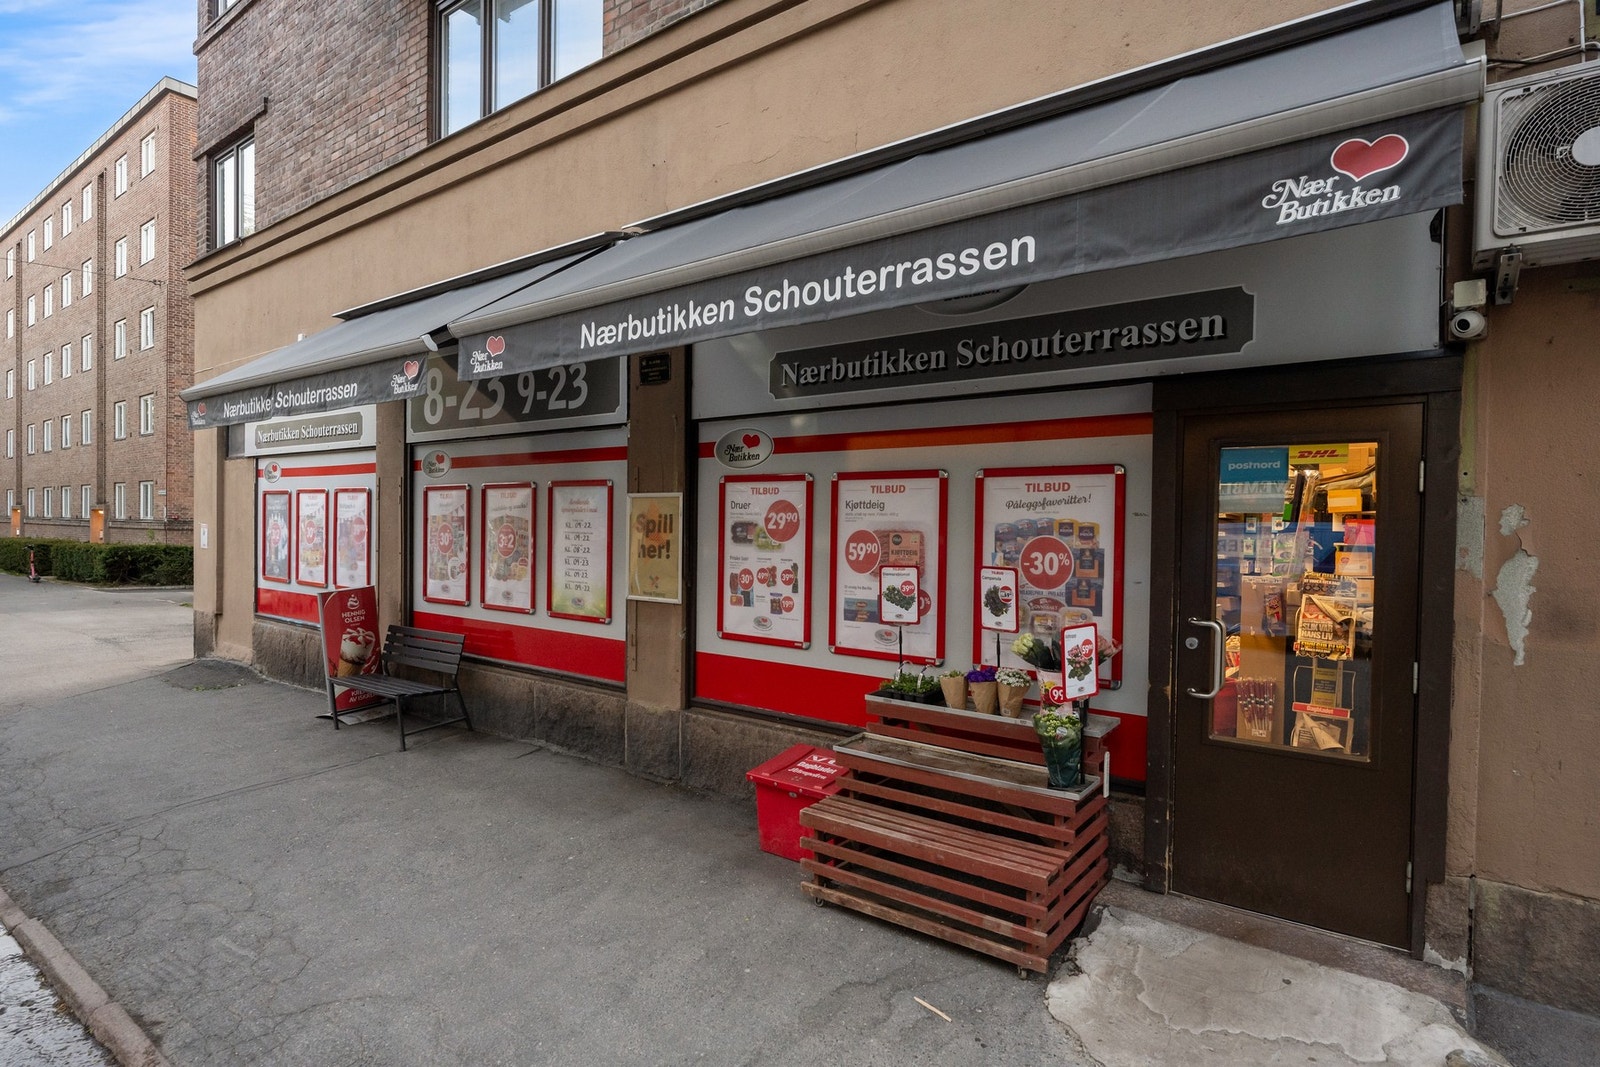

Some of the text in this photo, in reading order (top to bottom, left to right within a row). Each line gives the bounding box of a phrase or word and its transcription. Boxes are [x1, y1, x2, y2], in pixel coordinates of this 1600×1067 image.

[1262, 175, 1339, 208] Nær
[1276, 184, 1401, 225] Butikken
[580, 235, 1037, 349] Nærbutikken Schouterrassen
[780, 311, 1226, 388] Nærbutikken Schouterrassen
[473, 359, 504, 373] Butikken
[517, 362, 588, 414] 9-23
[223, 382, 358, 418] Nærbutikke Schouterrassen
[257, 420, 359, 444] Nærbutikken Schouterrassen
[724, 444, 744, 456] Nær
[1298, 449, 1340, 459] DHL
[729, 453, 760, 463] Butikken
[1228, 460, 1281, 472] postnord
[751, 487, 780, 495] TILBUD
[870, 485, 906, 494] TILBUD
[1025, 482, 1071, 492] TILBUD
[730, 500, 751, 510] Druer
[845, 500, 885, 511] Kjøttdeig
[1005, 494, 1092, 511] Påleggsfavoritter!
[635, 513, 674, 538] Spill
[637, 539, 671, 560] her!
[1023, 551, 1070, 575] -30%
[344, 615, 365, 624] OLSEN
